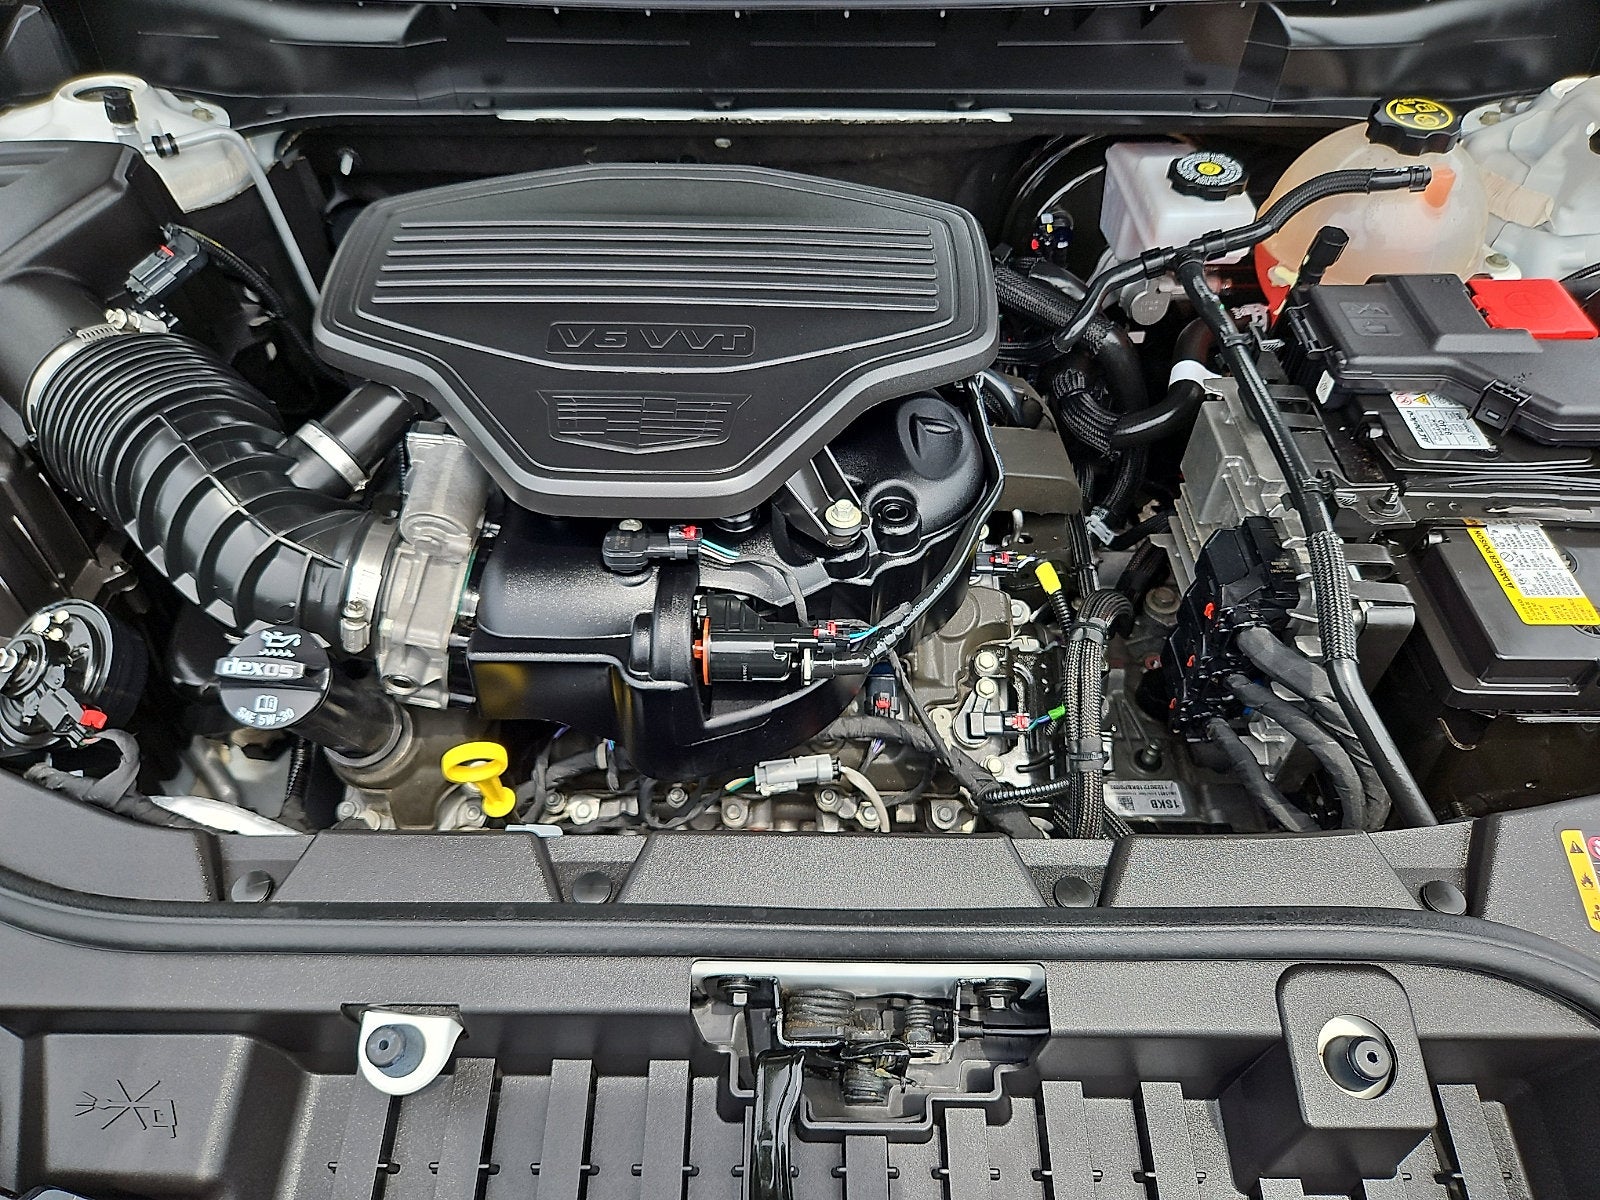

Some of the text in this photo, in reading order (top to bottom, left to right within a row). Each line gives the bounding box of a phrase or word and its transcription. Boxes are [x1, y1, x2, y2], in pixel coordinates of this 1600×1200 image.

[556, 328, 747, 351] V6 VVT
[1474, 530, 1511, 582] DANGER POISON
[221, 657, 297, 678] dexos
[236, 706, 295, 726] SAE 5W-30
[1150, 799, 1180, 809] 1SKB
